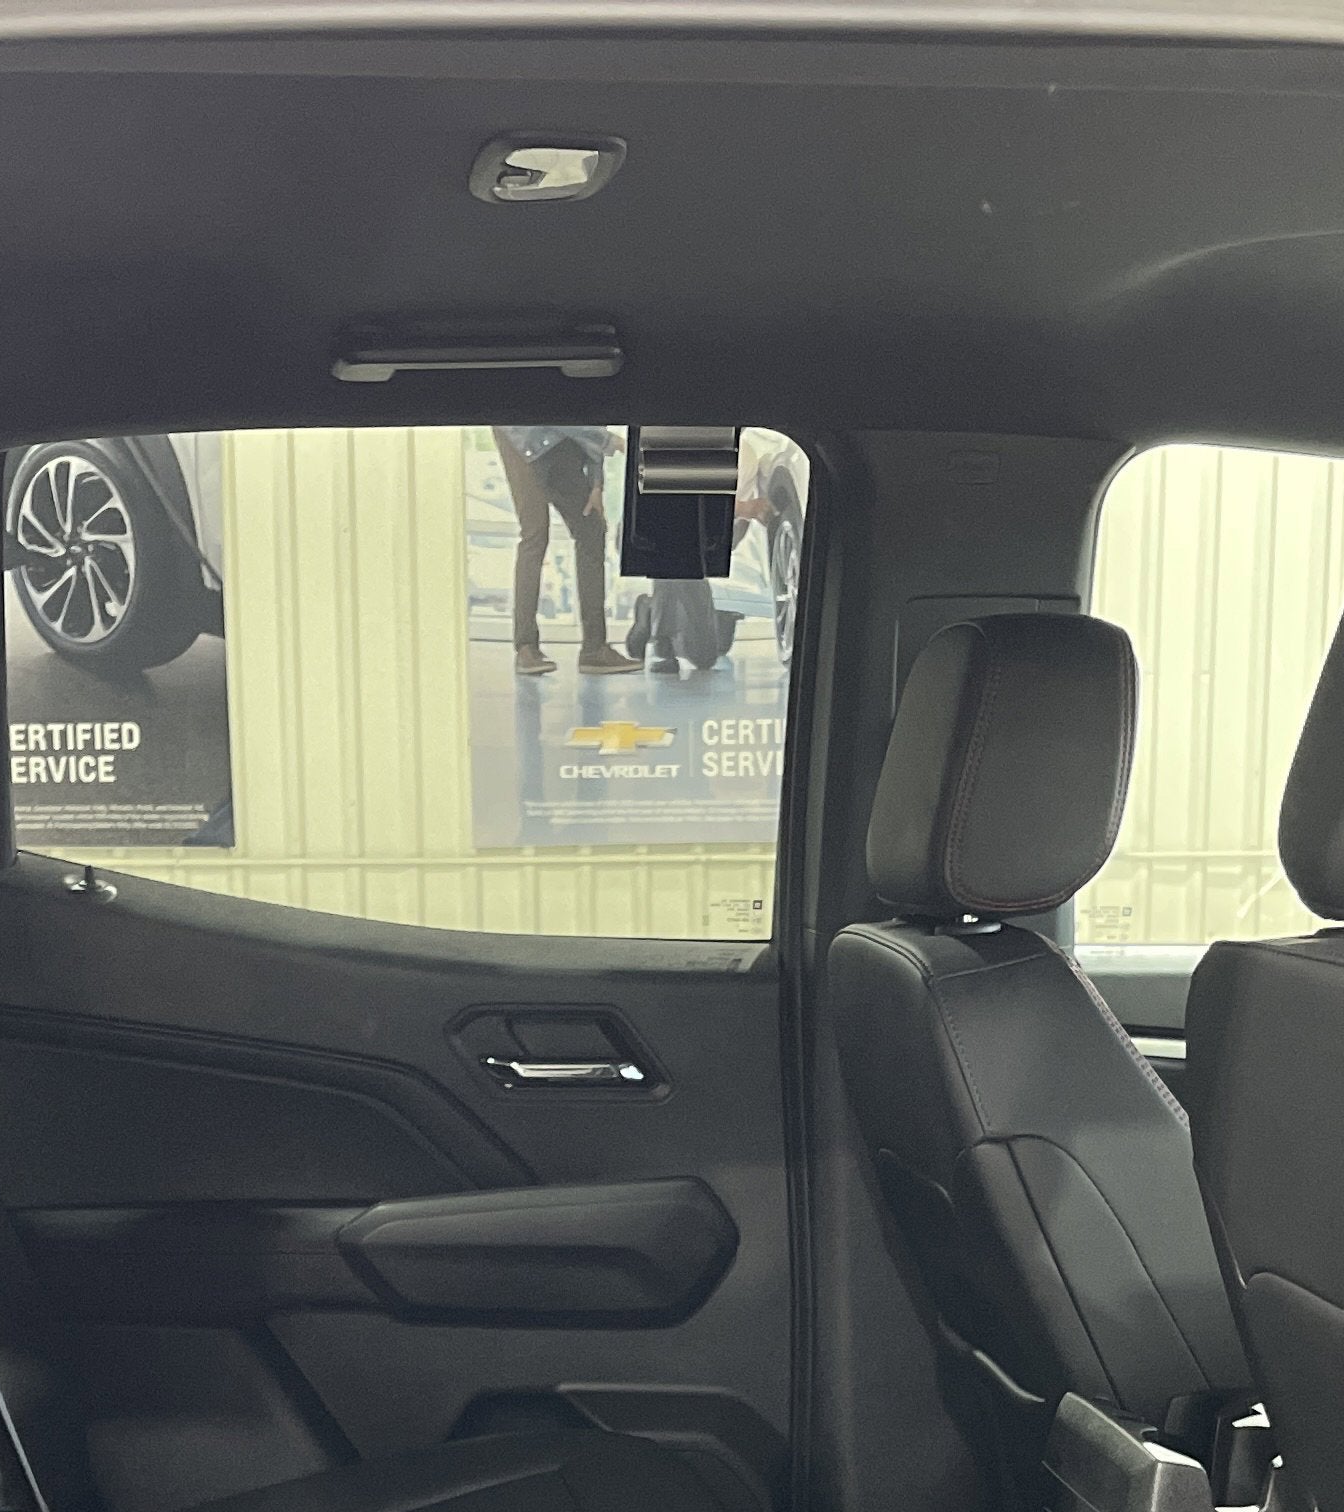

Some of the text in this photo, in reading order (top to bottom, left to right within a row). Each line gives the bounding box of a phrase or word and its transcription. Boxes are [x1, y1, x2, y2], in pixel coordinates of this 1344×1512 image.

[9, 722, 141, 751] ERTIFIED
[702, 719, 782, 745] CERTI
[11, 755, 116, 783] ERVICE
[559, 764, 681, 779] CHEVROLET
[702, 752, 783, 777] SERVI
